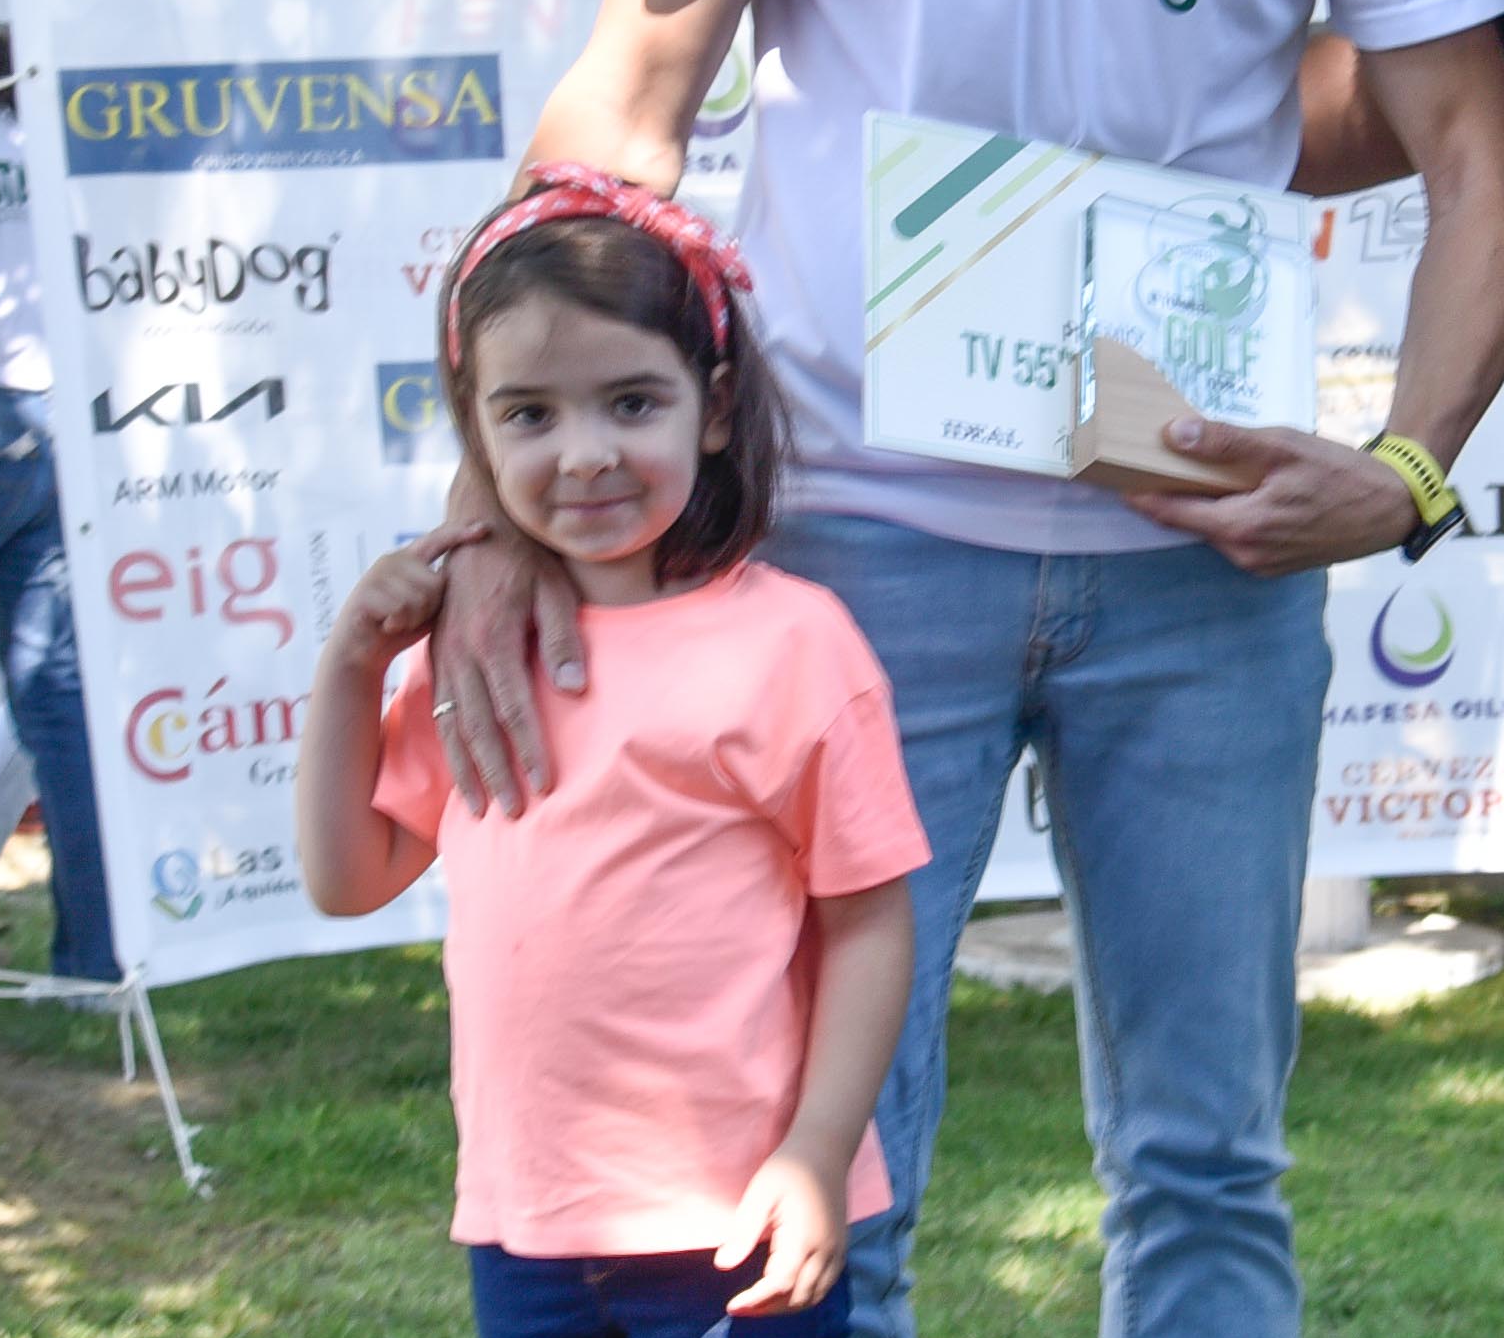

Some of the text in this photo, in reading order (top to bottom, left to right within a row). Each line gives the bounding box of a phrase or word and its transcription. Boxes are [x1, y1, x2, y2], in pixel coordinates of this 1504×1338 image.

[66, 69, 500, 141] GRUVENSA
[959, 328, 1006, 382] TV
[92, 376, 287, 435] KIA
[112, 467, 283, 507] ARM Motor
[107, 537, 295, 650] eig
[124, 675, 310, 783] Cám
[1341, 756, 1496, 786] CERVEZ
